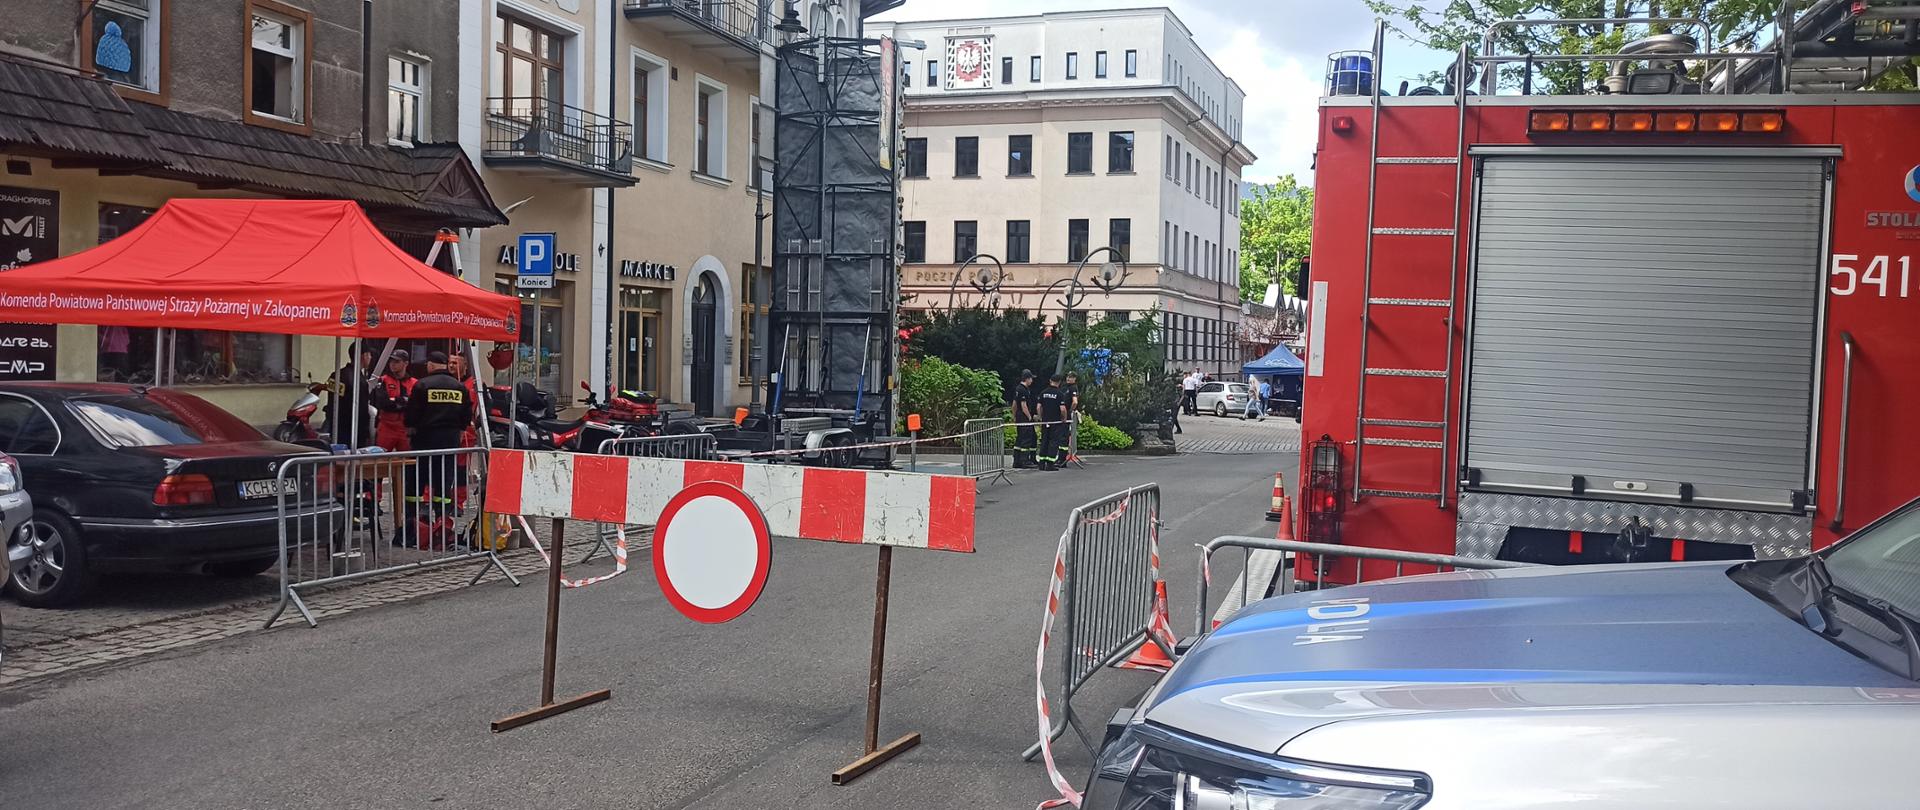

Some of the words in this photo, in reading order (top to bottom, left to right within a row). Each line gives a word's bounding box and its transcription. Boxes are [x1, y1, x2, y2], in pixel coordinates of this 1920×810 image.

[525, 239, 545, 270] P
[622, 259, 679, 281] MARKET
[1830, 253, 1920, 298] 541
[521, 277, 548, 286] Koniec
[0, 292, 47, 309] Komenda
[50, 293, 103, 310] Powiatowa
[106, 294, 168, 315] Państwowej
[169, 296, 201, 317] Straży
[204, 298, 250, 319] Pożarnej
[252, 305, 262, 315] w
[264, 300, 331, 322] Zakopanem
[383, 309, 416, 323] Komenda
[417, 310, 451, 323] Powiatowa
[451, 311, 463, 324] PSP
[464, 315, 469, 324] w
[469, 314, 504, 329] Zakopanem
[244, 481, 270, 495] KCH
